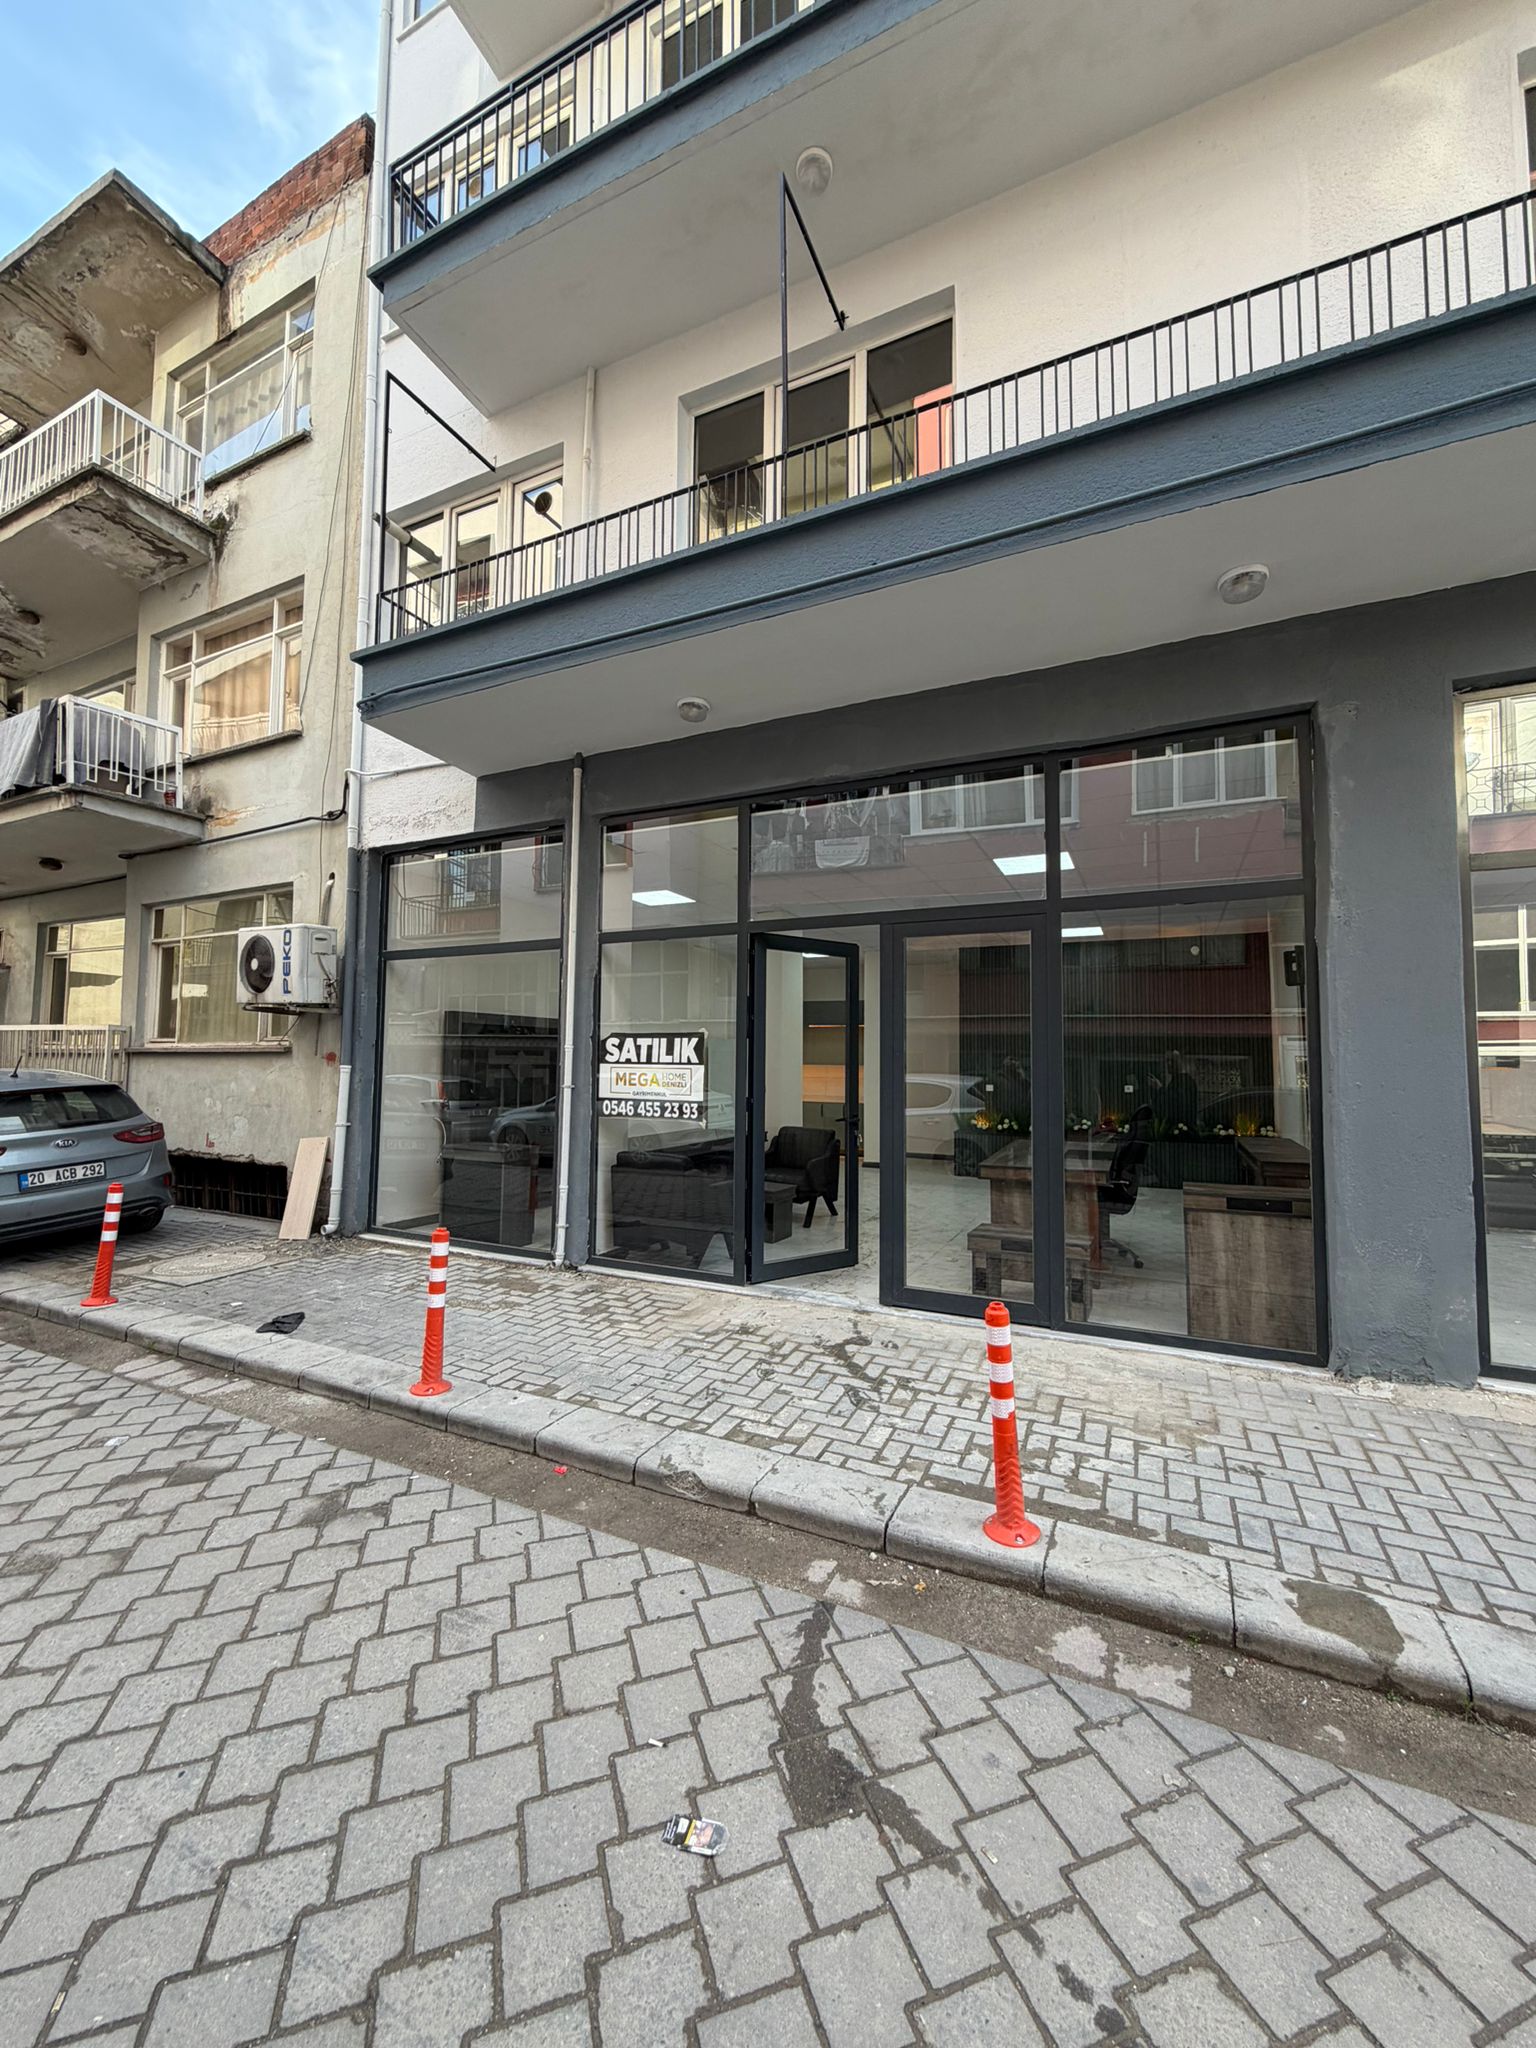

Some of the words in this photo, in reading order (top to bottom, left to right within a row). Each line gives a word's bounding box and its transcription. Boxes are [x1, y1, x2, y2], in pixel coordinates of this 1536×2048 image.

[605, 1037, 699, 1063] SATILIK
[615, 1072, 660, 1087] MEGA
[662, 1072, 687, 1082] HOME
[603, 1100, 634, 1115] 0546
[637, 1101, 661, 1116] 455
[664, 1102, 679, 1117] 23
[683, 1103, 698, 1118] 93
[29, 1173, 45, 1185] 20
[56, 1168, 77, 1181] ACB
[82, 1164, 103, 1177] 292
